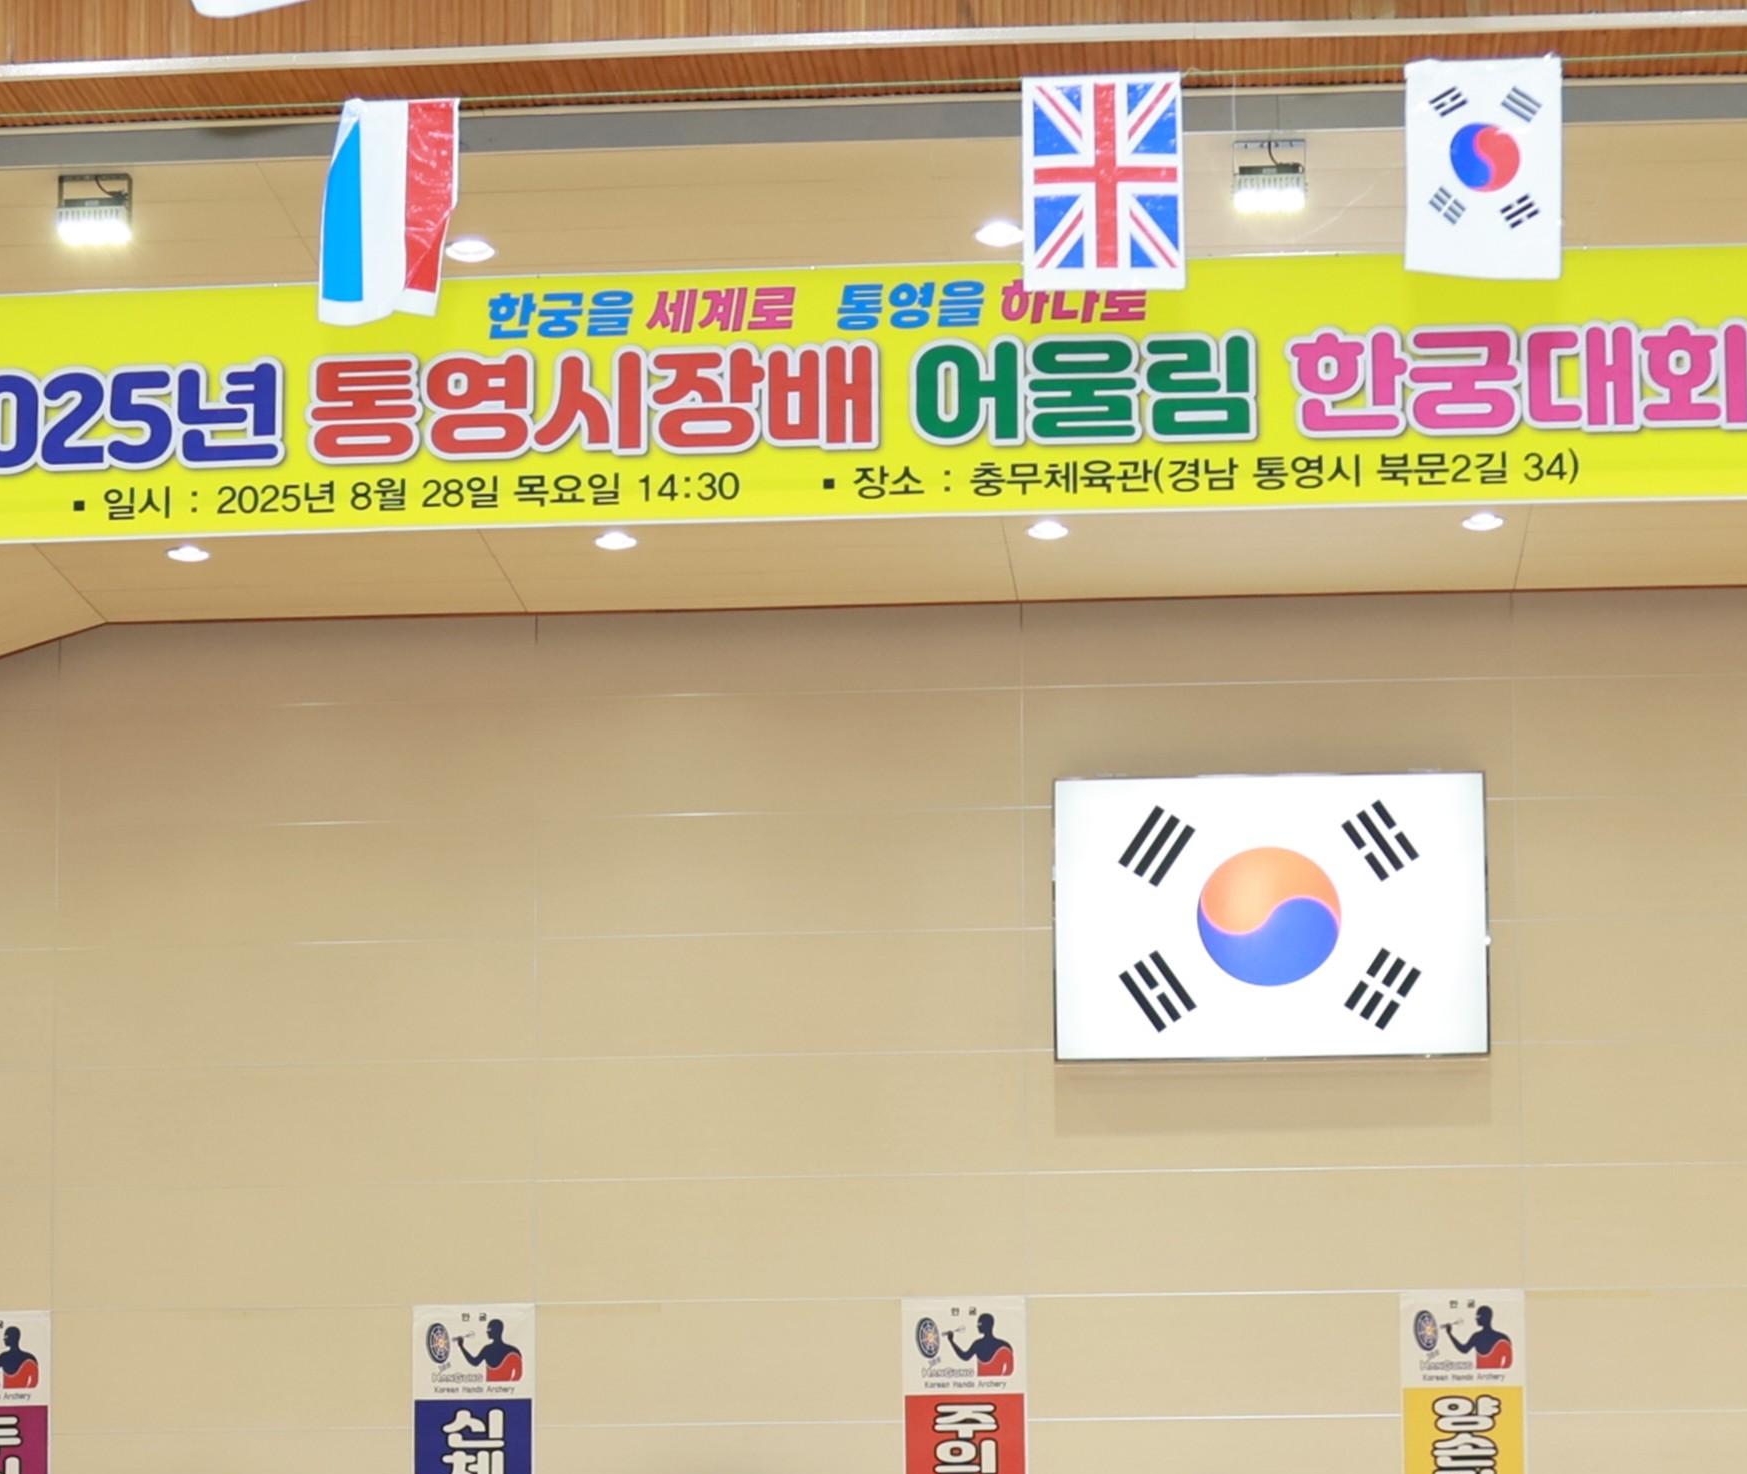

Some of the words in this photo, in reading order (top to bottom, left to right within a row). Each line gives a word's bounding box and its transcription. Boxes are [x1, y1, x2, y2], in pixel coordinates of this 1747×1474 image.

[488, 290, 633, 339] 한궁을
[647, 286, 795, 334] 세계로
[837, 280, 985, 331] 통영을
[310, 344, 878, 461] 통영시장배
[912, 331, 1255, 443] 어울림
[103, 485, 171, 521] 일시
[216, 480, 335, 514] 2025년
[350, 477, 407, 511] 8월
[422, 475, 499, 508] 28일
[513, 472, 620, 507] 목요일
[638, 472, 739, 501] 14:30
[853, 464, 925, 499] 장소
[969, 456, 1238, 496] 충무체육관(경남
[1255, 453, 1361, 490] 통영시
[1376, 451, 1508, 486] 북문2길
[1523, 447, 1580, 485] 34)
